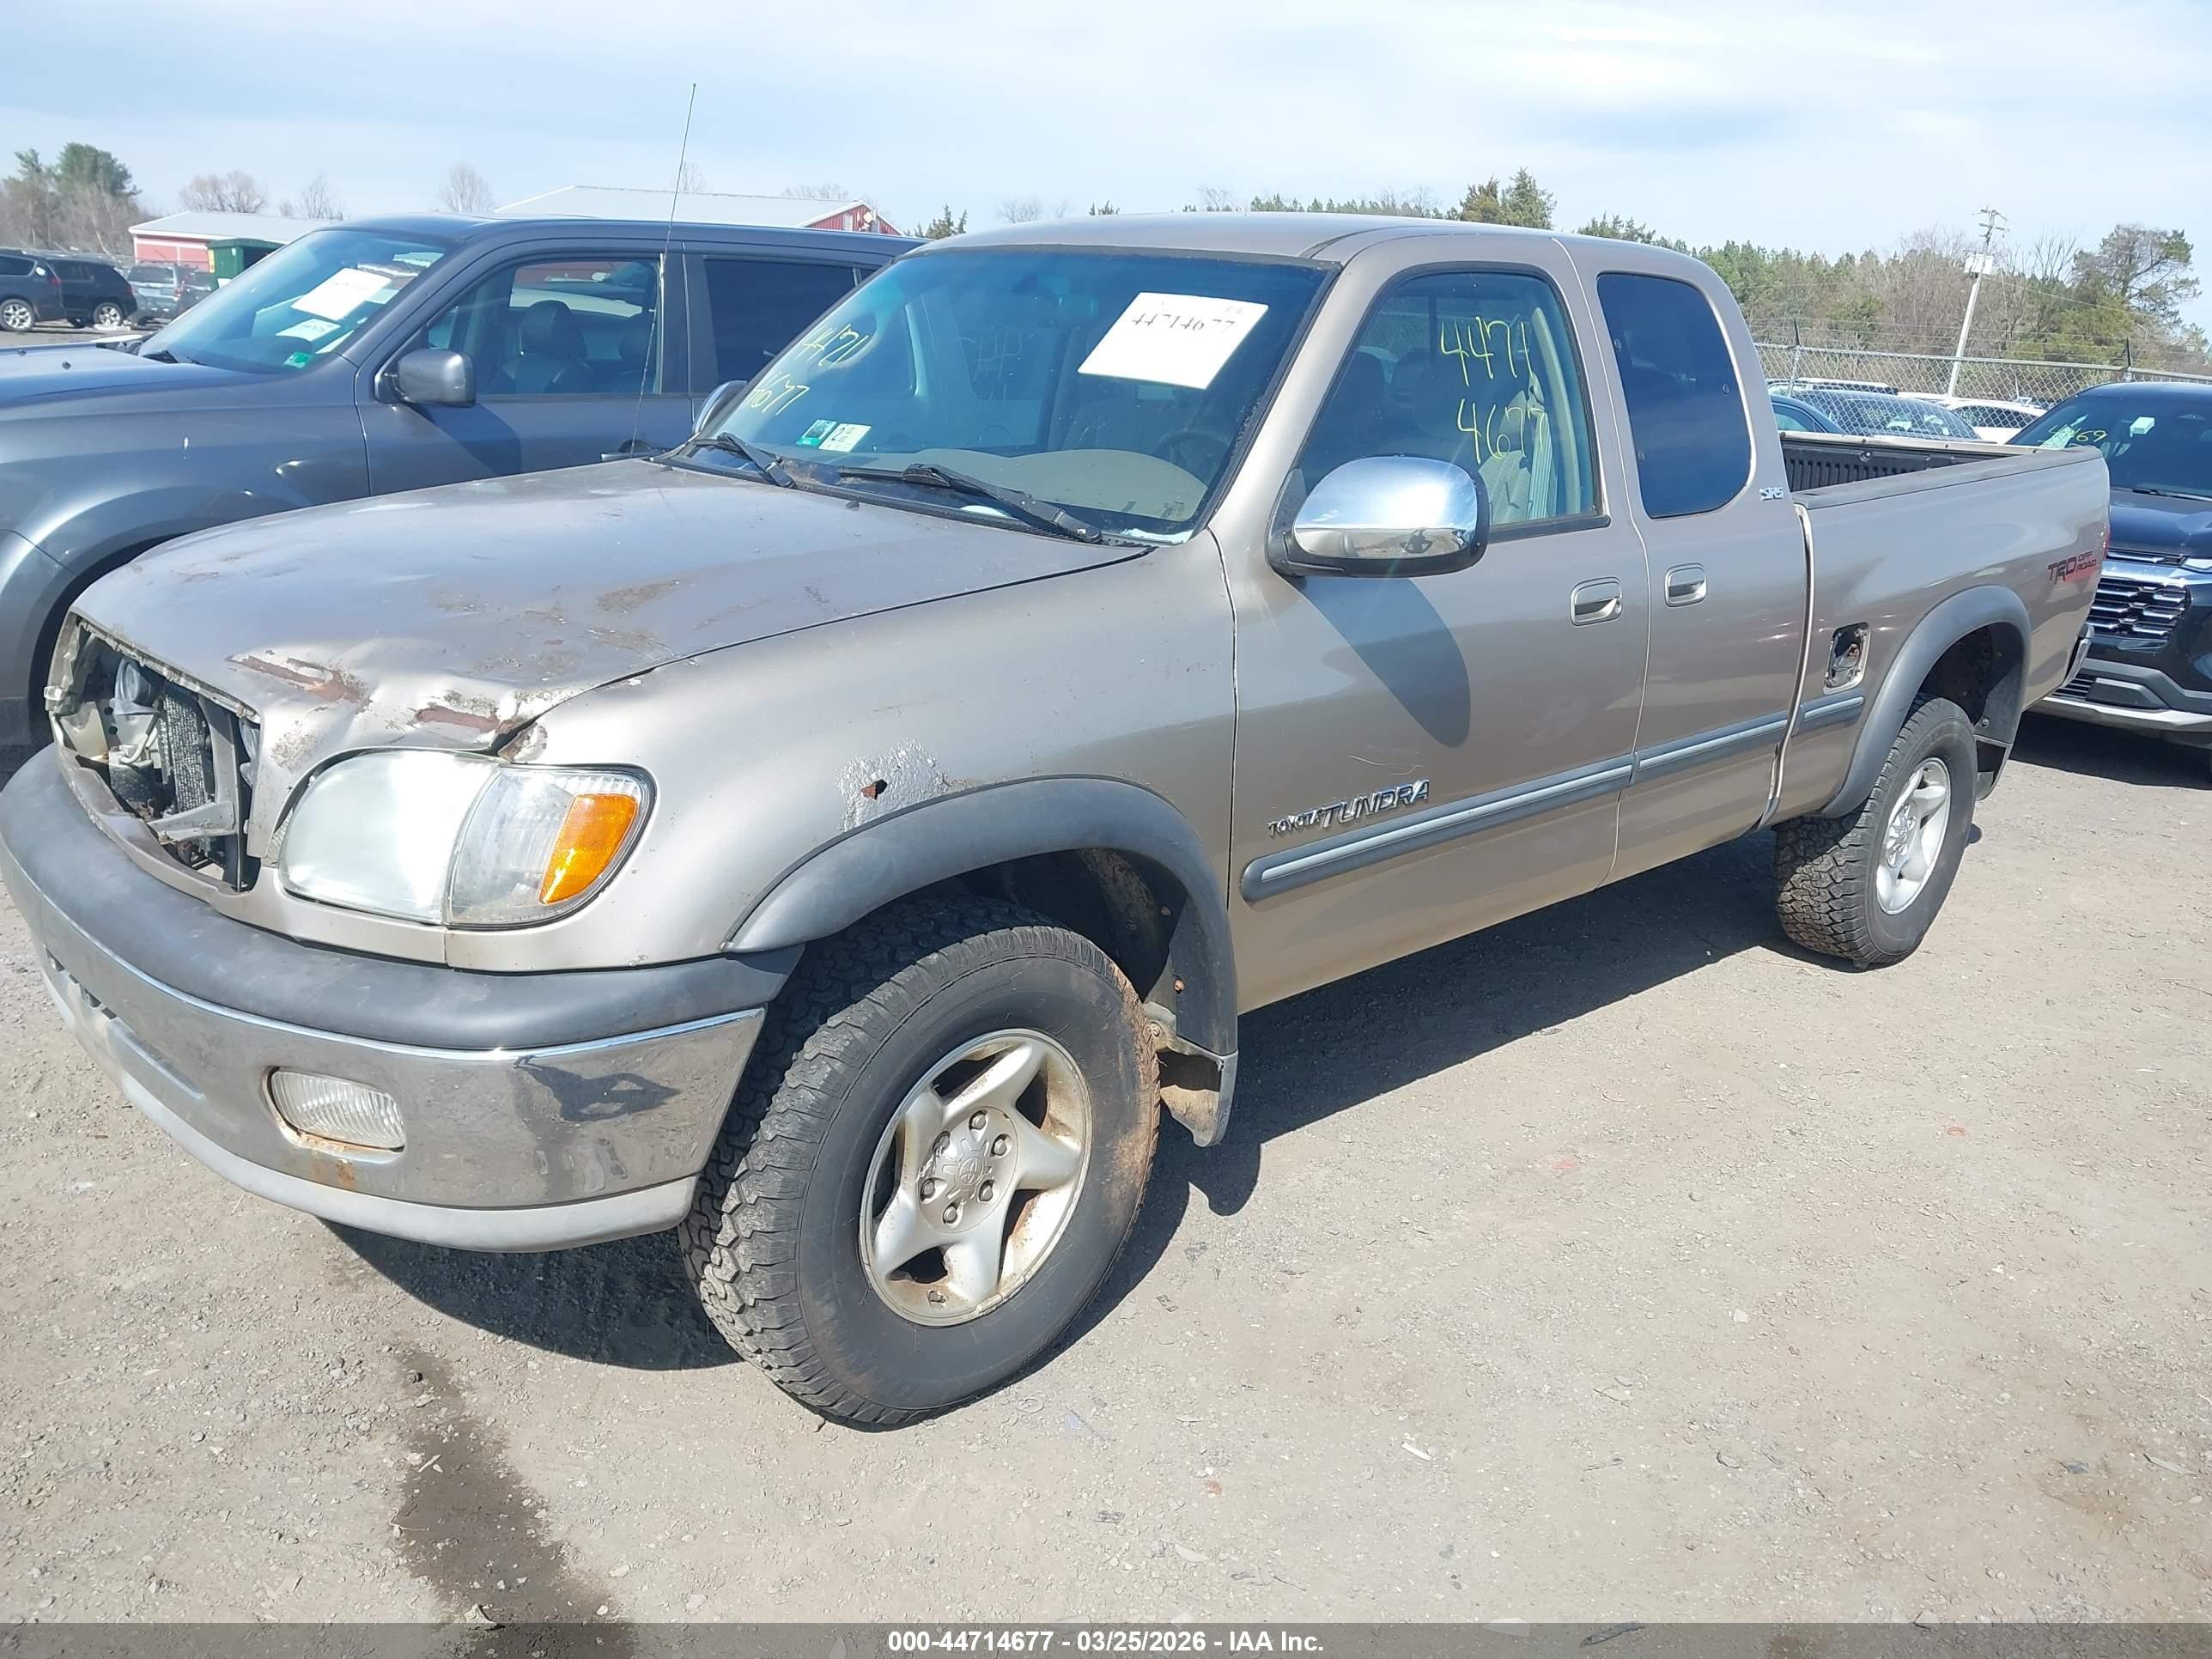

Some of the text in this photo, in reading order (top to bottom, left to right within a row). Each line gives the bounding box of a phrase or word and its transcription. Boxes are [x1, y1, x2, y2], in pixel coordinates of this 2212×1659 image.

[1441, 316, 1534, 387] 4471
[1457, 398, 1546, 465] 4677
[2047, 556, 2077, 585] TRD
[1267, 779, 1430, 837] TOYOTA TUNDRA
